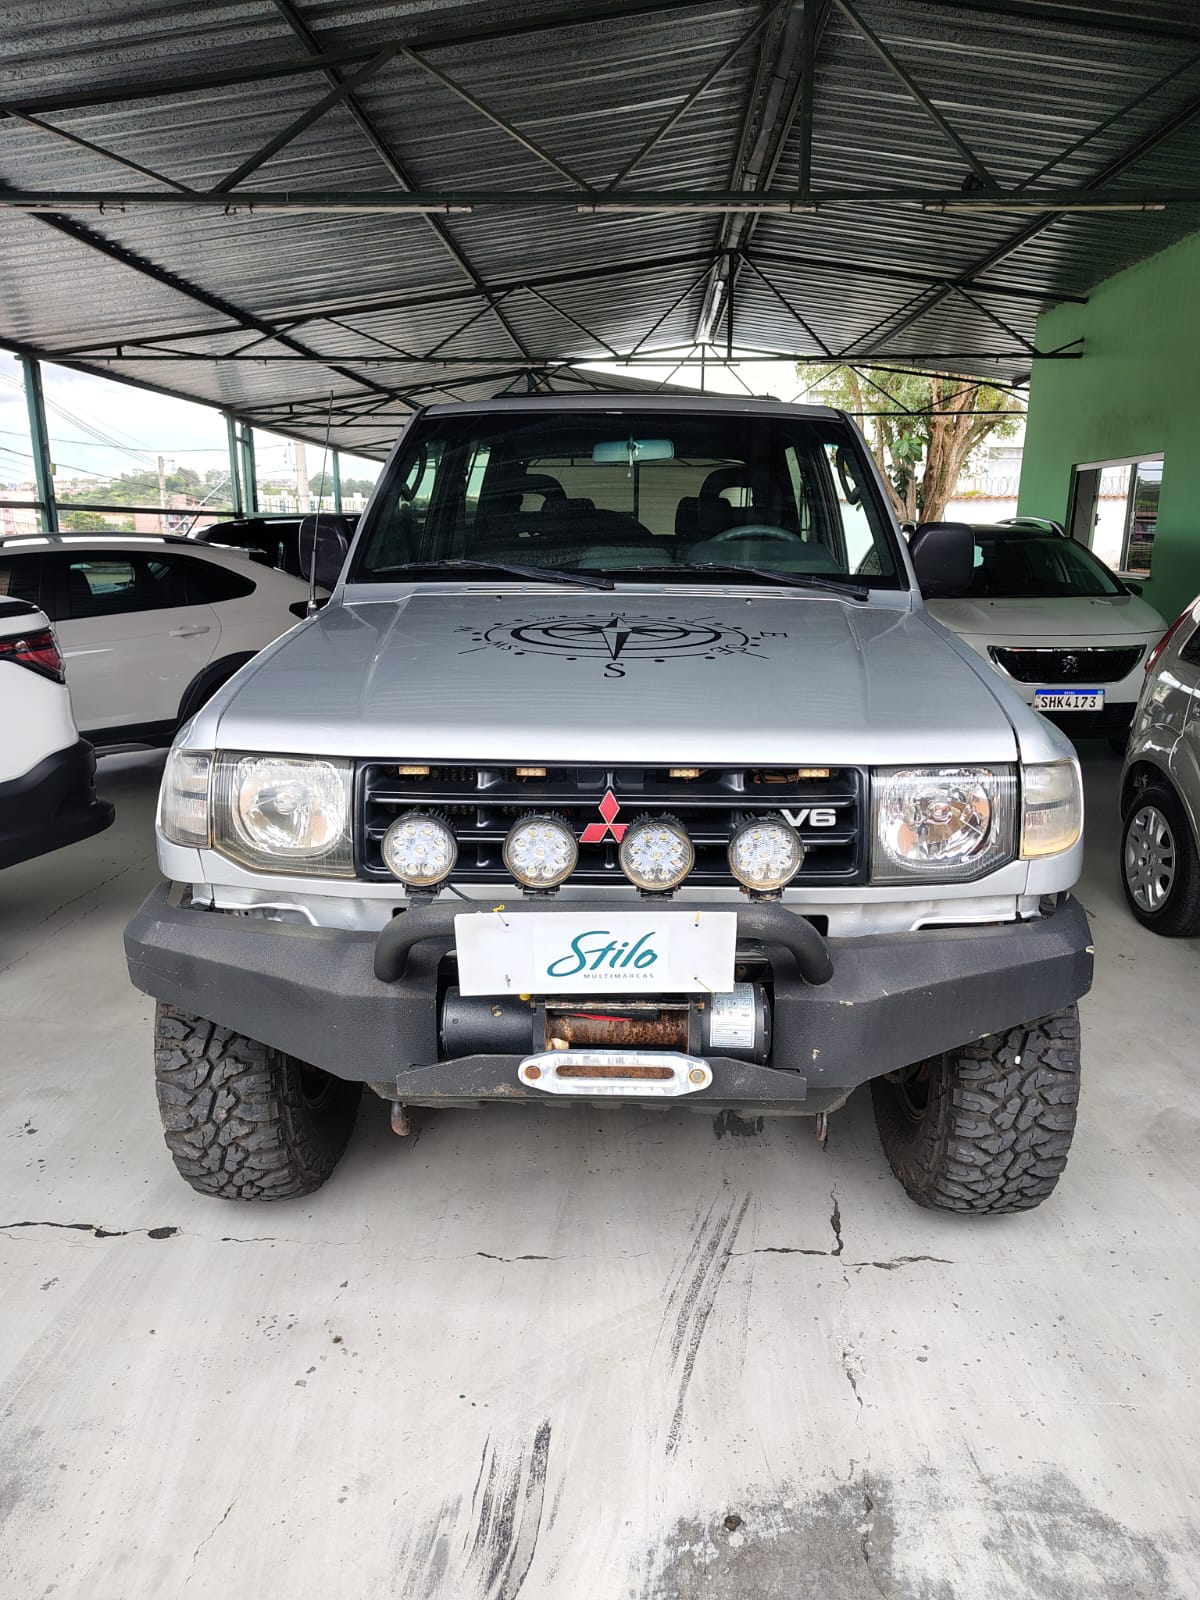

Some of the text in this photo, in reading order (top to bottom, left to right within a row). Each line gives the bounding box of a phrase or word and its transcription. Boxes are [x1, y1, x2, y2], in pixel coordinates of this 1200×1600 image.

[603, 662, 626, 678] S
[779, 808, 837, 827] V6
[546, 930, 658, 977] Stilo
